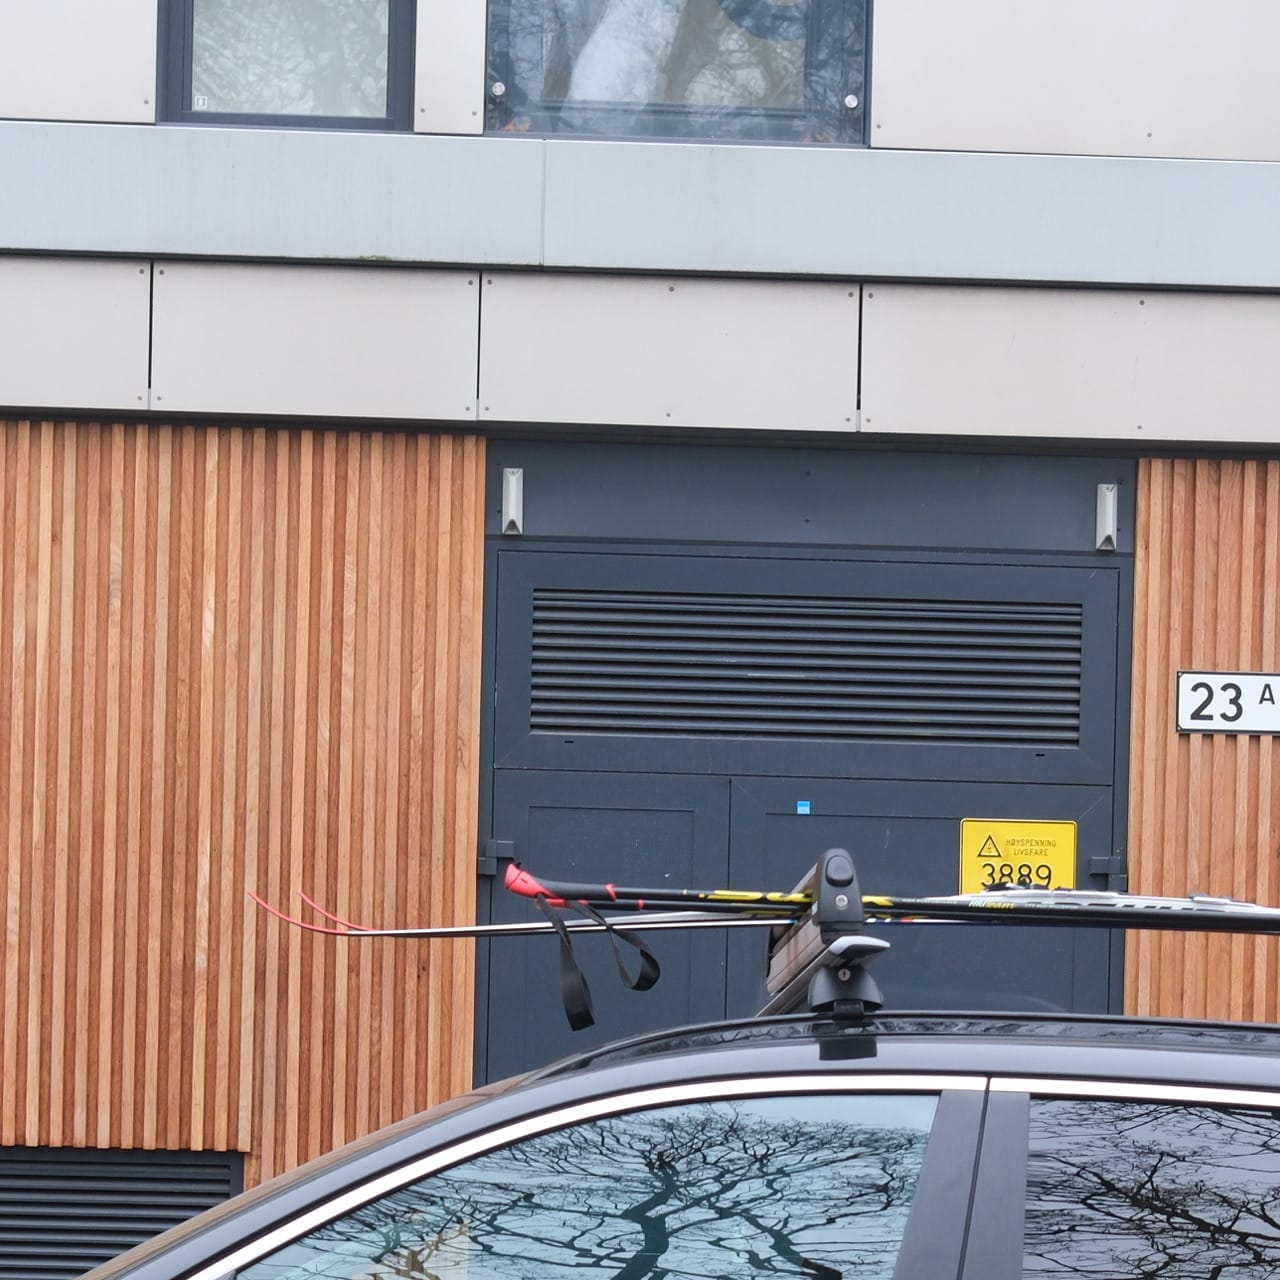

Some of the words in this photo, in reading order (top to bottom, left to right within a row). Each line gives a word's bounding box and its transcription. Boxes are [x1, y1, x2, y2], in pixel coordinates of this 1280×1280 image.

[1190, 681, 1244, 722] 23
[1258, 683, 1276, 705] A
[1013, 848, 1049, 856] LIVSFARE
[980, 862, 1052, 888] 3889
